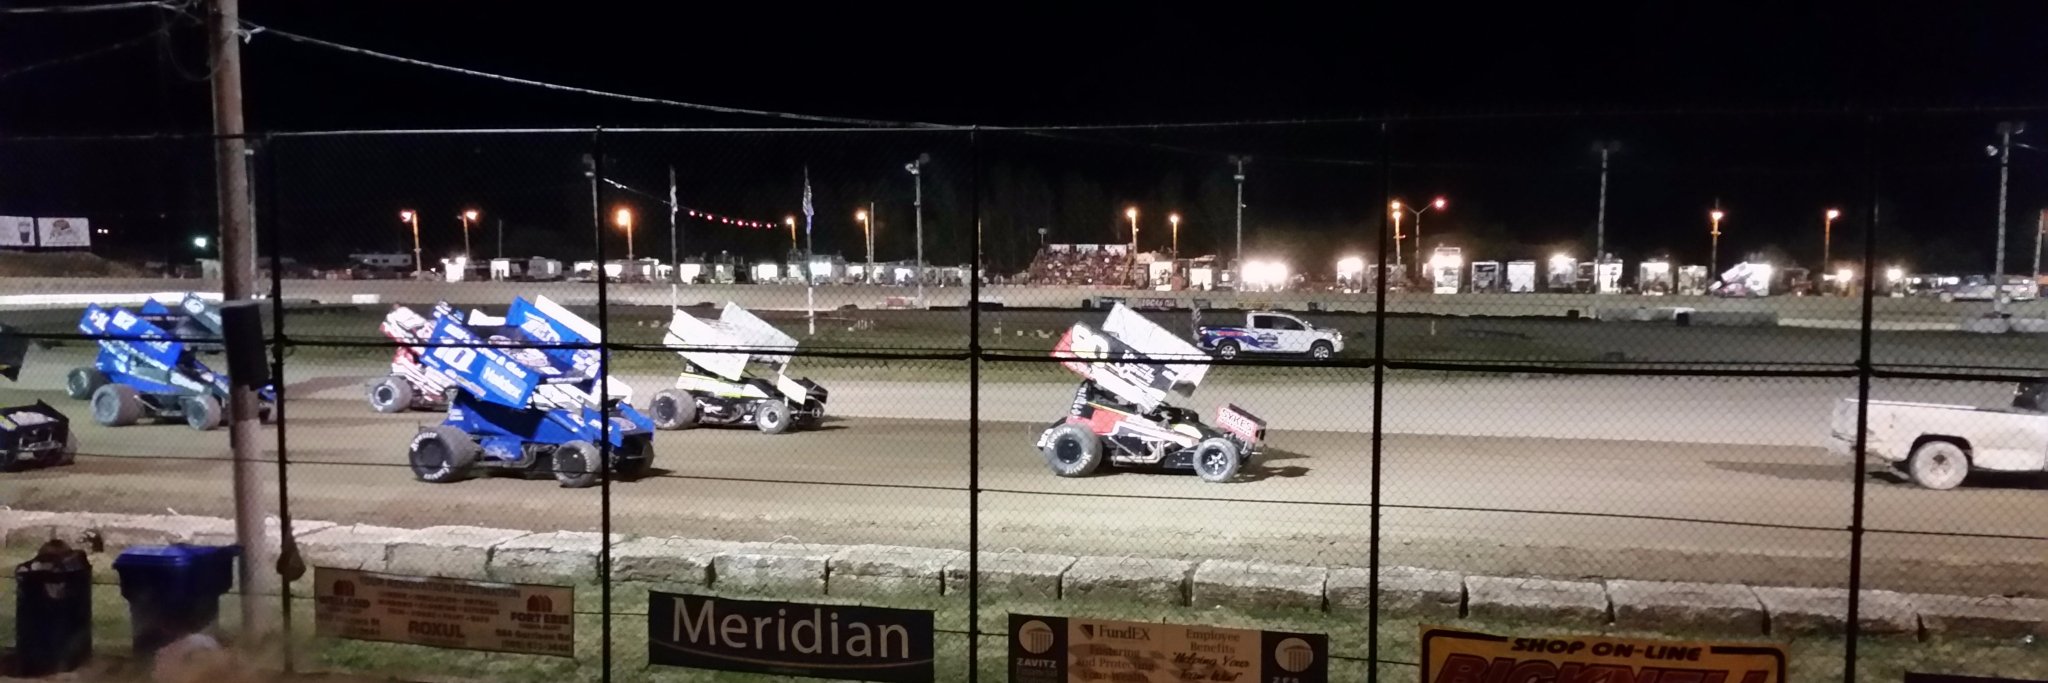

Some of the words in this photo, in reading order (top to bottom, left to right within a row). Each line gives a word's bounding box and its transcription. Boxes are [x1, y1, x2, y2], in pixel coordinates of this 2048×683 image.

[511, 611, 541, 623] FORT
[408, 620, 466, 639] ROXUL
[672, 596, 910, 659] Meridian
[1099, 624, 1151, 641] FundEX
[1186, 629, 1241, 642] Employee
[1190, 641, 1236, 655] Benefits
[1510, 637, 1586, 655] SHOP
[1591, 640, 1703, 661] ON-LINE
[1017, 657, 1057, 669] ZAVITZ
